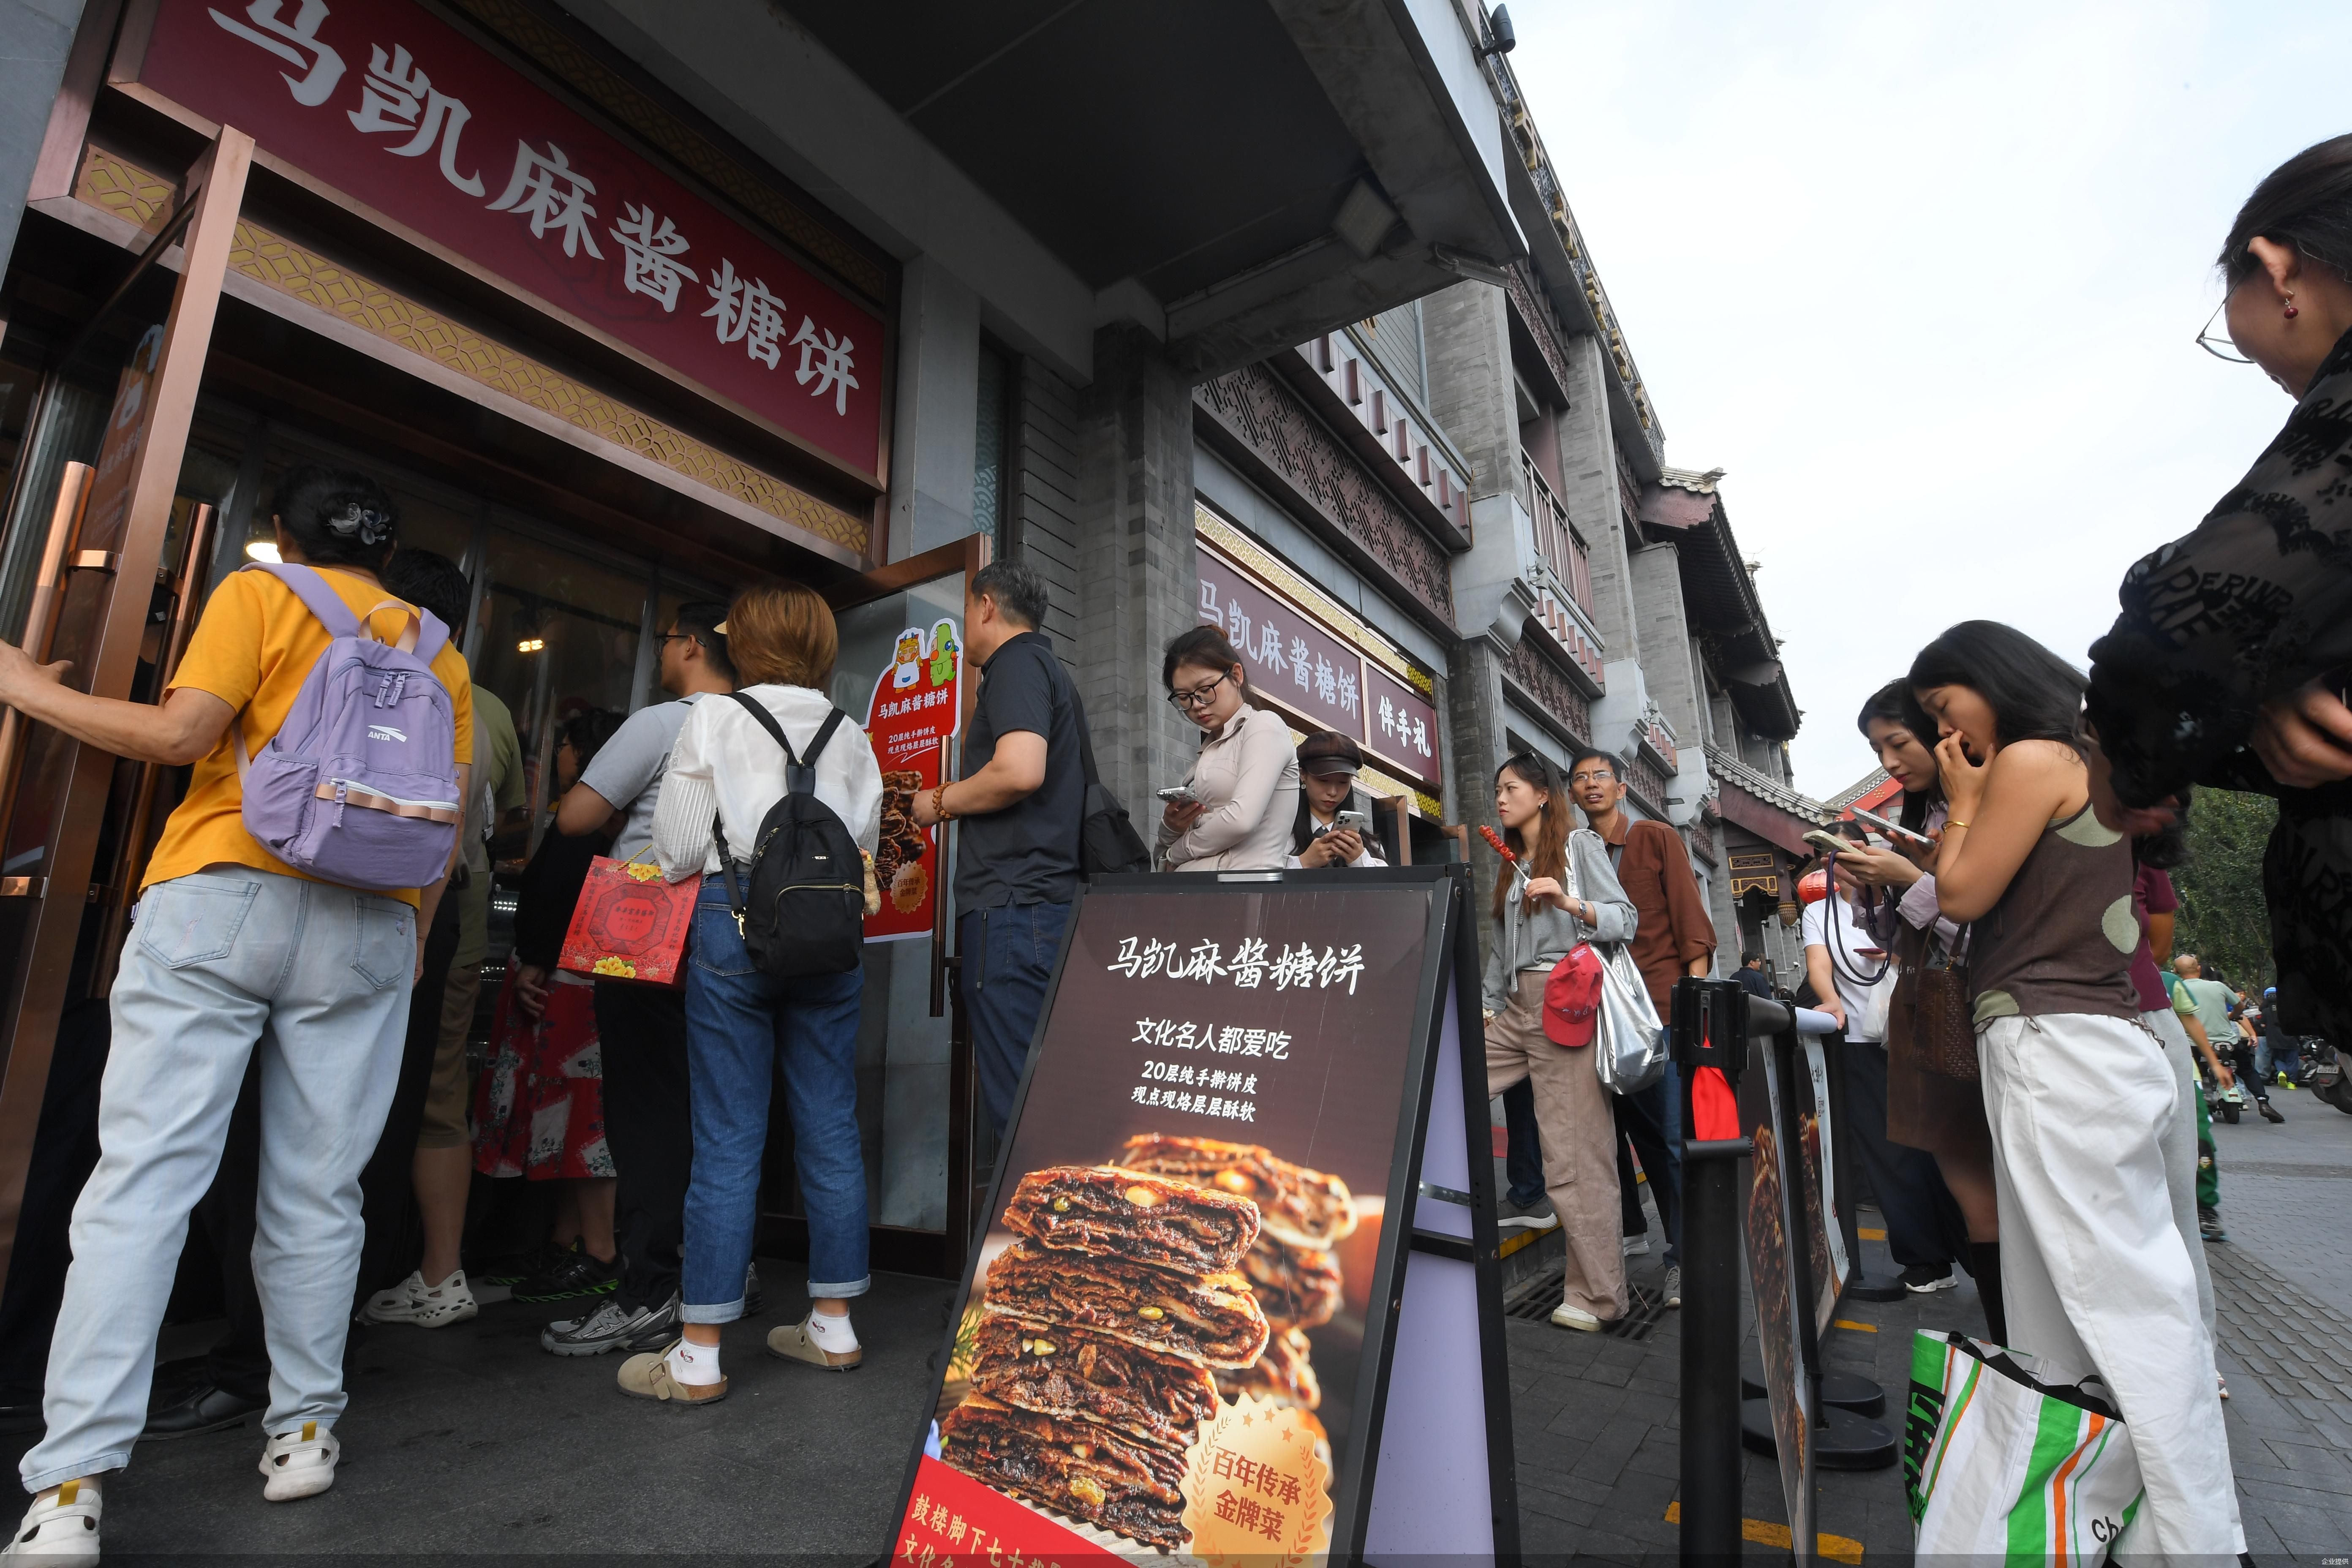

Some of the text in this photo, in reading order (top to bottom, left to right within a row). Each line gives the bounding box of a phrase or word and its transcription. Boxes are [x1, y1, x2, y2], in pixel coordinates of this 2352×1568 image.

[207, 0, 859, 416] 马凯麻酱糖饼
[1198, 579, 1359, 720] 马凯麻酱糖饼
[878, 688, 948, 719] 马凯麻酱糖饼
[368, 731, 391, 741] ANTA
[888, 726, 936, 743] 20层纯手擀饼皮
[1378, 695, 1432, 758] 伴手礼
[887, 737, 939, 754] 现点现烙层层酥软
[897, 877, 920, 887] 百年传承
[900, 887, 917, 896] 金牌菜
[1107, 936, 1365, 995] 马凯麻酱糖饼
[1131, 1017, 1292, 1060] 文化名人都爱吃
[1141, 1061, 1258, 1094] 20层纯手擀饼皮
[1131, 1086, 1256, 1122] 现点现烙层层酥软
[1212, 1446, 1302, 1505] 百年传承
[1213, 1489, 1285, 1543] 金牌菜
